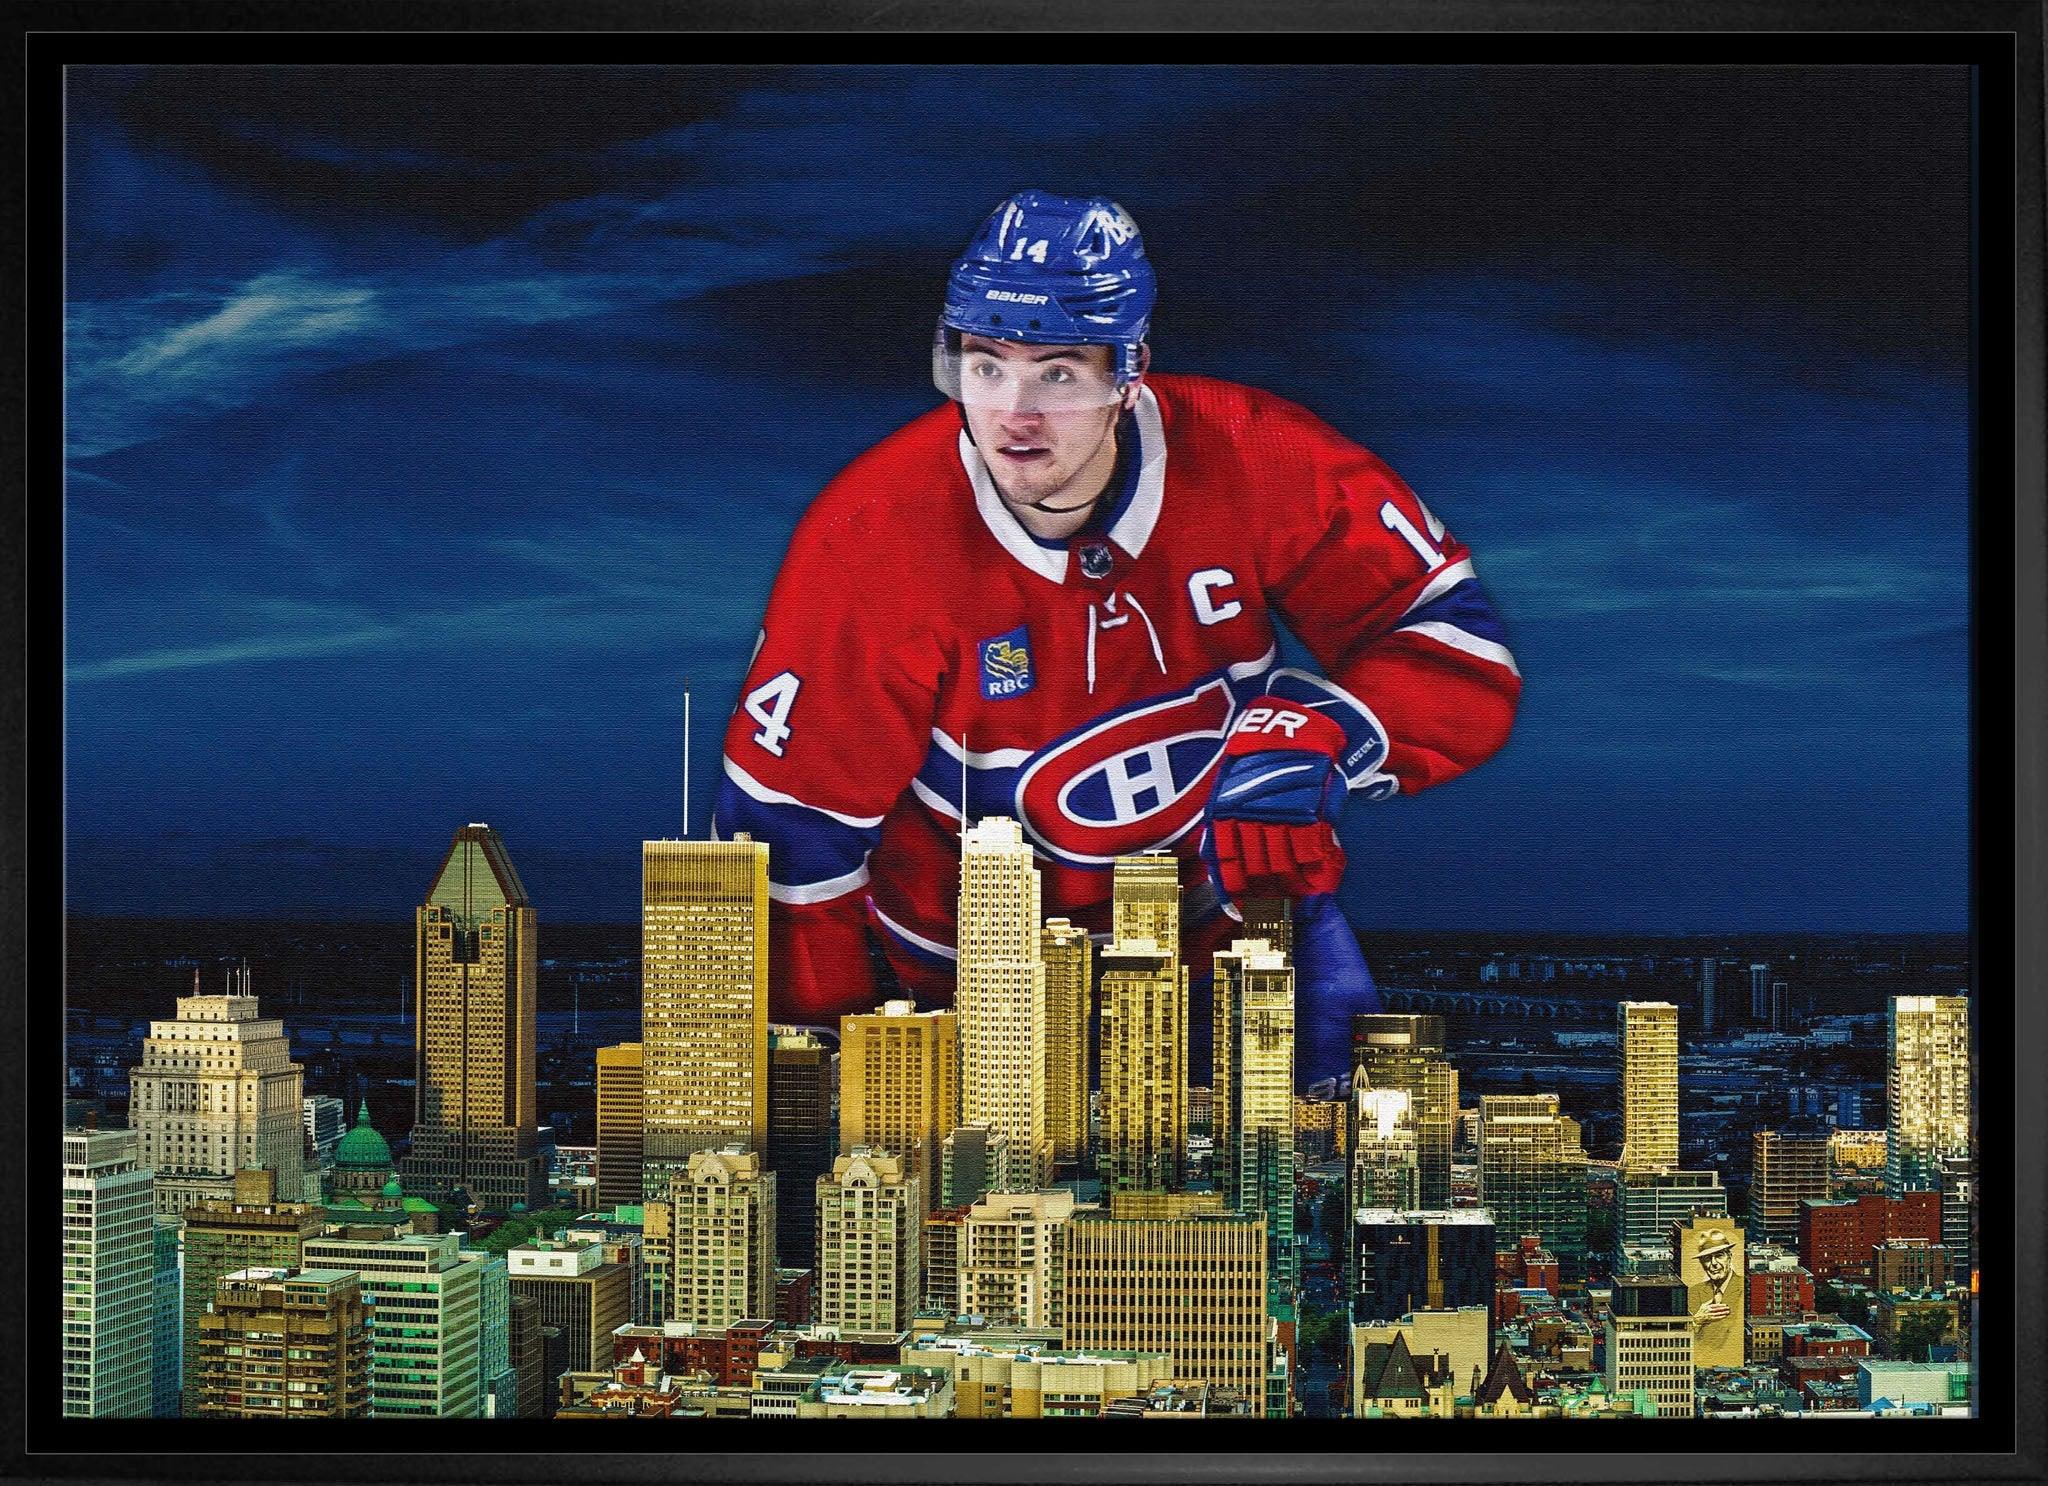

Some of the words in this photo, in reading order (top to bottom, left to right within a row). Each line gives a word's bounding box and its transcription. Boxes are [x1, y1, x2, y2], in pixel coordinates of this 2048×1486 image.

[1010, 237, 1050, 264] 14
[985, 289, 1049, 305] BAUER
[1188, 568, 1242, 626] C
[734, 638, 801, 758] 4
[988, 674, 1030, 696] RBC
